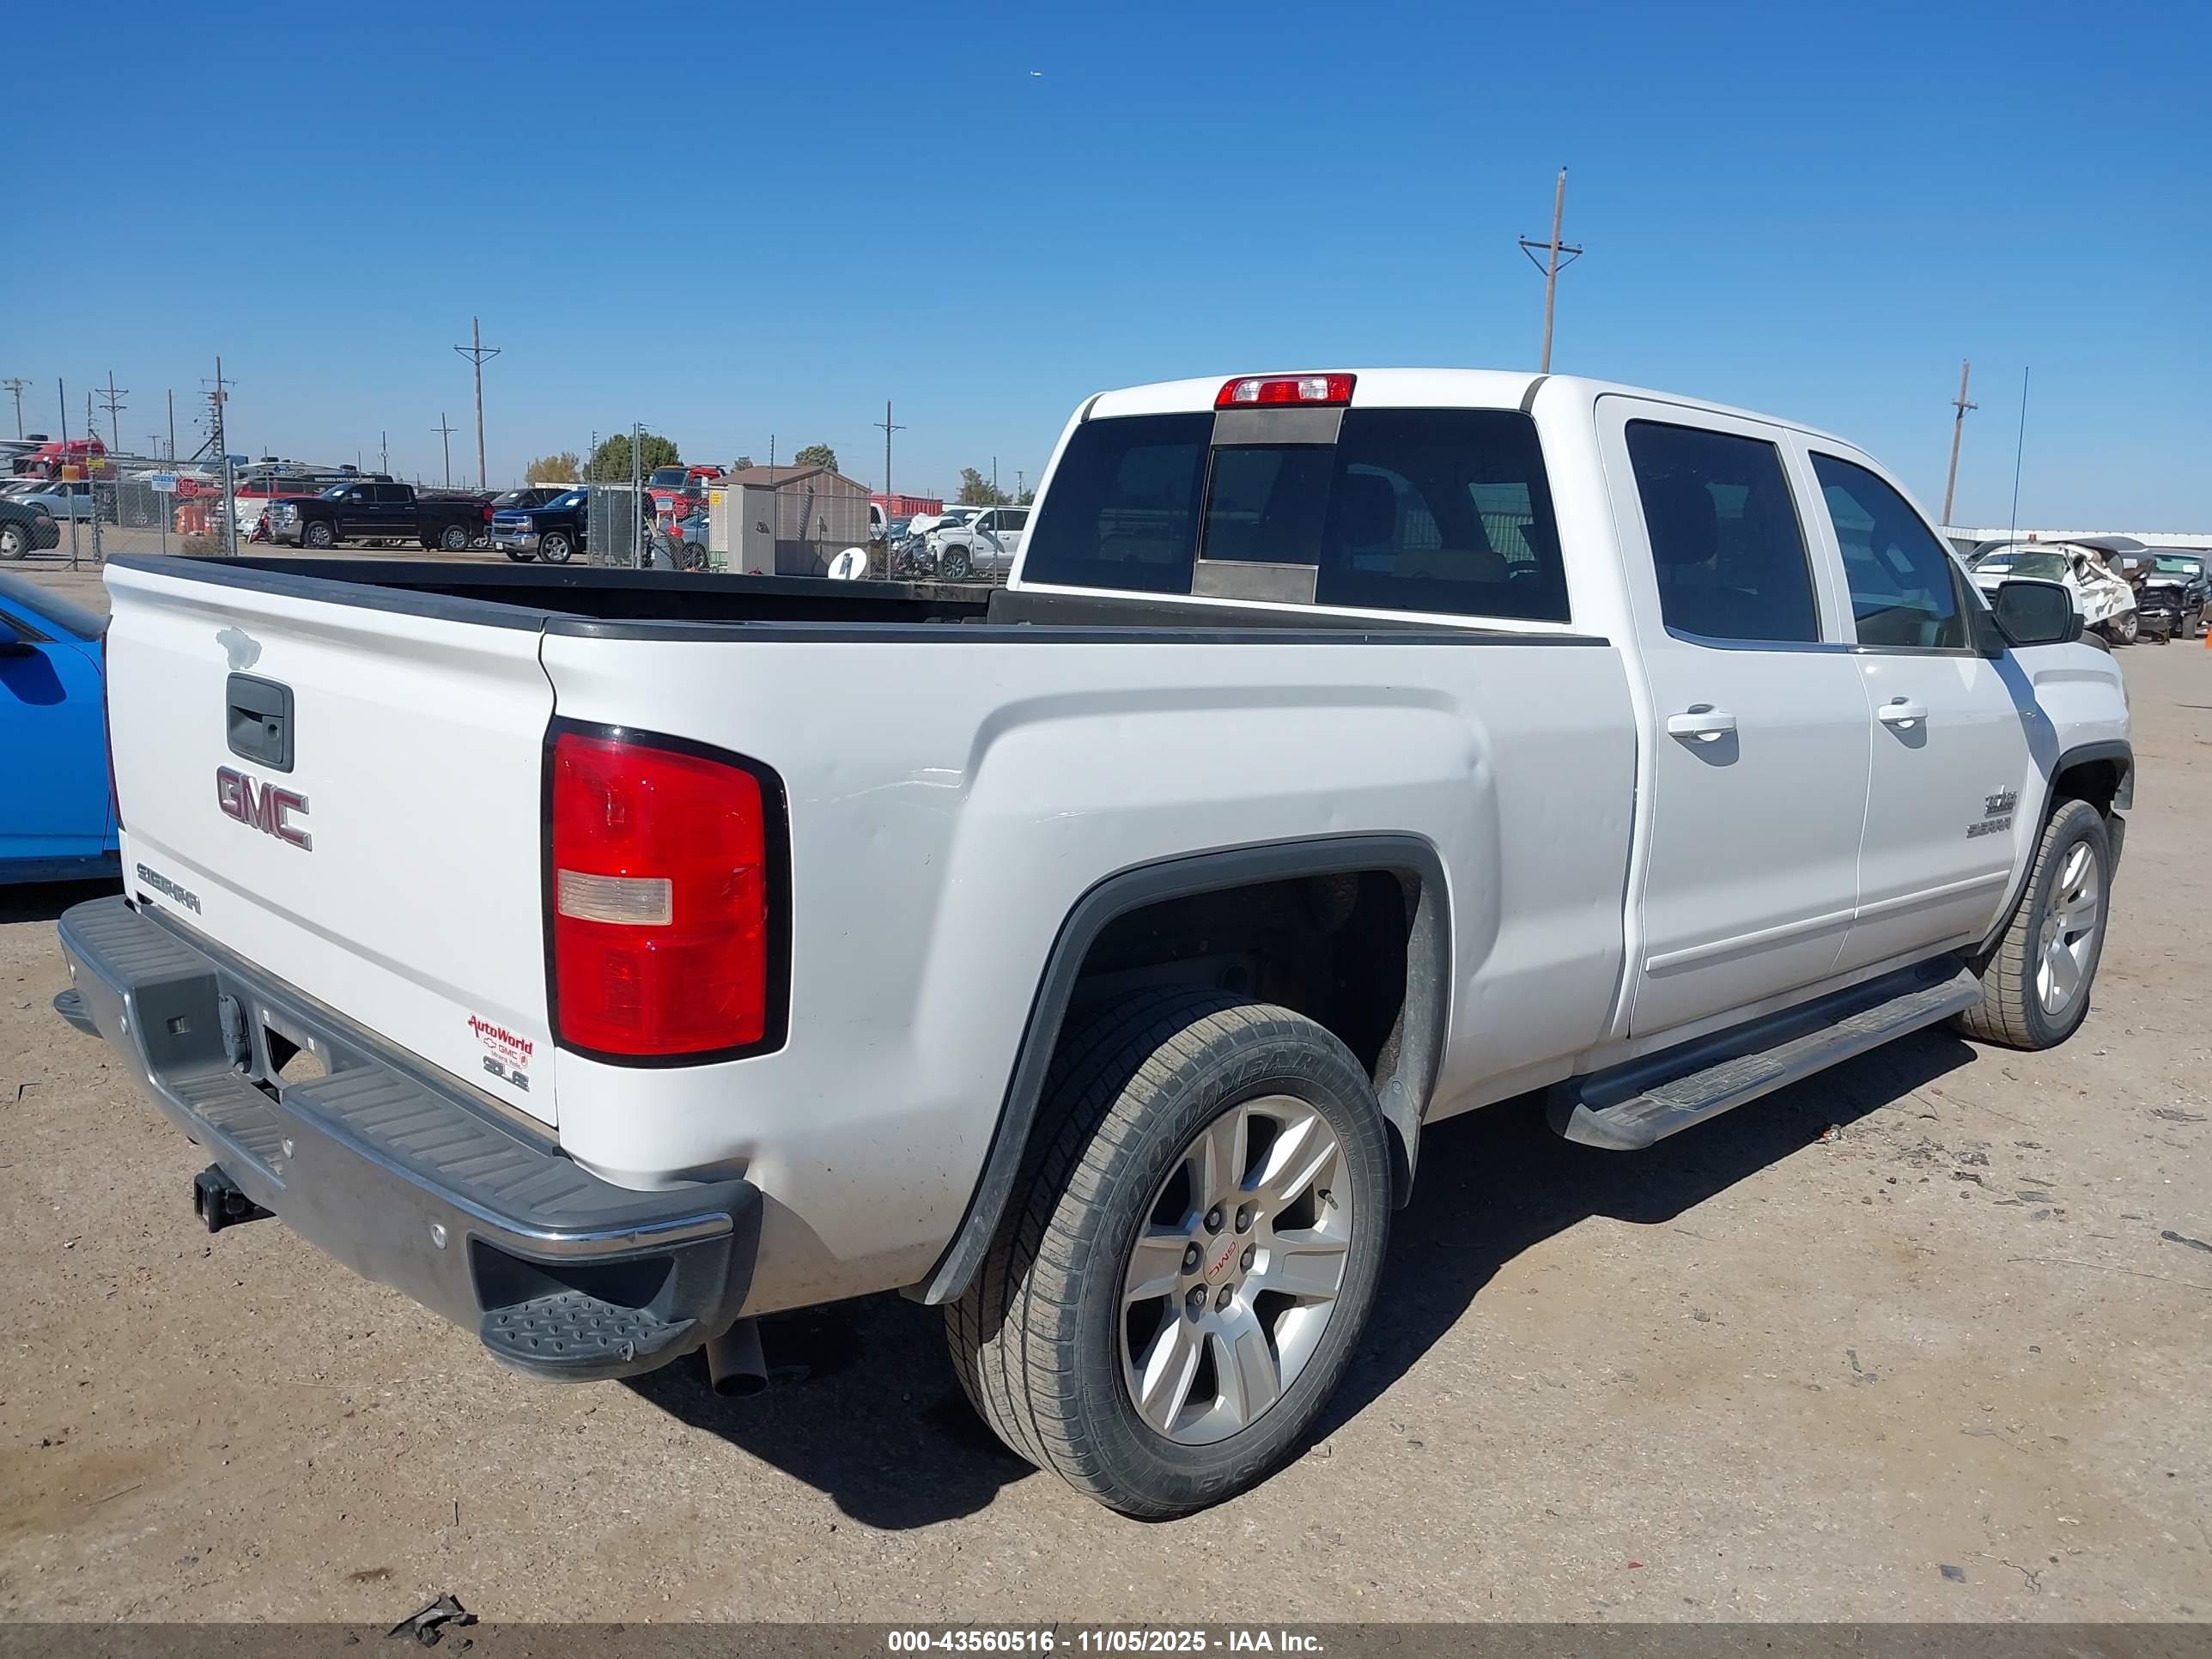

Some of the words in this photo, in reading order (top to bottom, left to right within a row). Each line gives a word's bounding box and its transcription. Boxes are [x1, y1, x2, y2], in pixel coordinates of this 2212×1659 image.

[216, 765, 313, 853] GMC
[1966, 817, 2011, 839] SIERRA
[137, 862, 202, 915] SIERRA
[468, 1015, 532, 1055] AutoWorld
[499, 1044, 517, 1060] GMC
[483, 1055, 530, 1093] SLE
[1109, 1048, 1320, 1260] GOODYEAR
[1208, 1241, 1237, 1279] GMC
